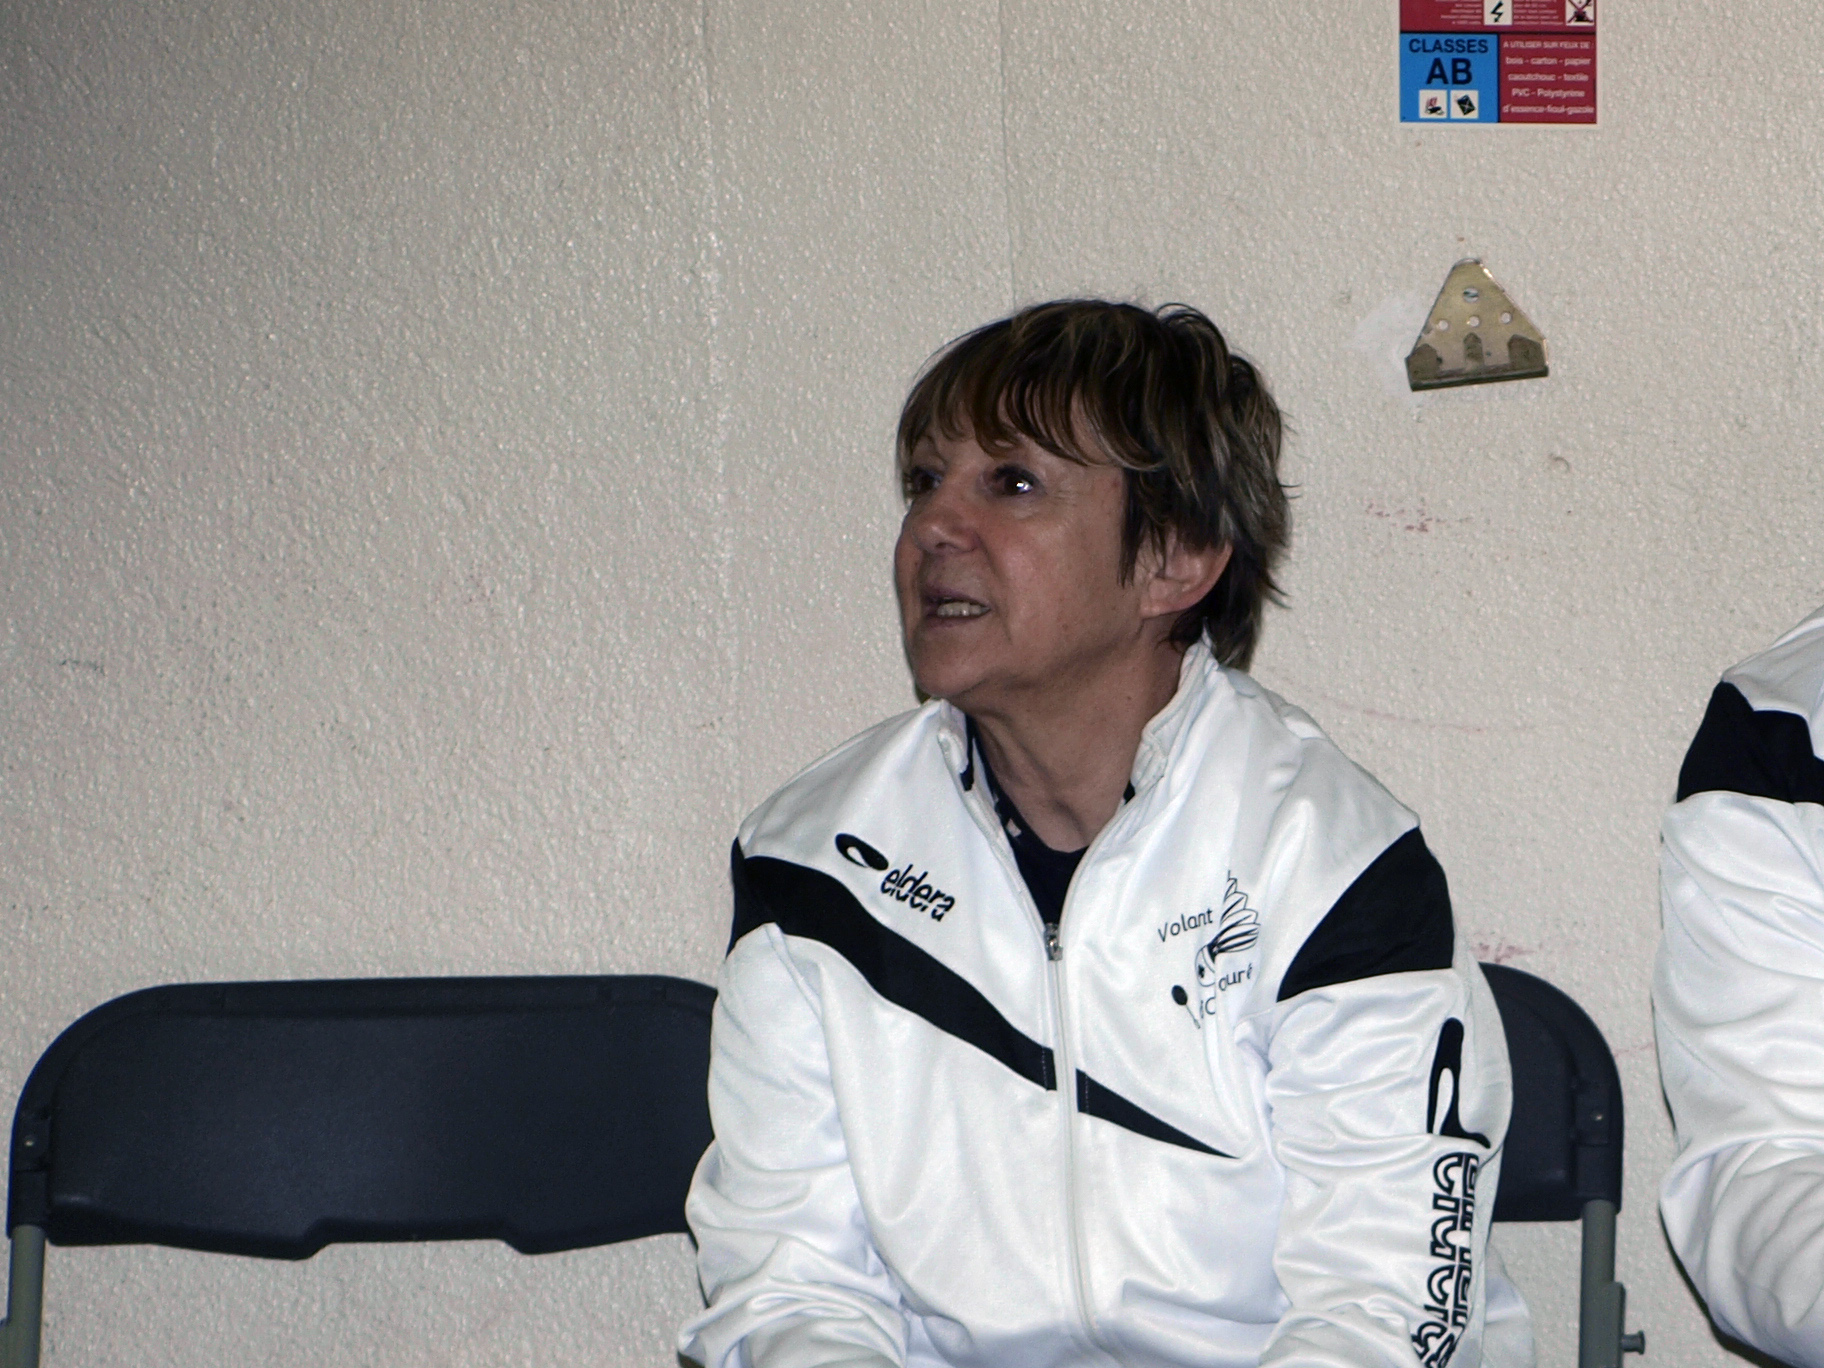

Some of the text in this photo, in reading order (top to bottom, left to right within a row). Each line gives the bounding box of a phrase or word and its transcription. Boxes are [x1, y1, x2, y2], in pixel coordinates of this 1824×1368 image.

[1409, 38, 1489, 53] CLASSES
[1426, 58, 1472, 85] AB
[880, 863, 956, 922] eldera
[1158, 908, 1213, 942] Volant
